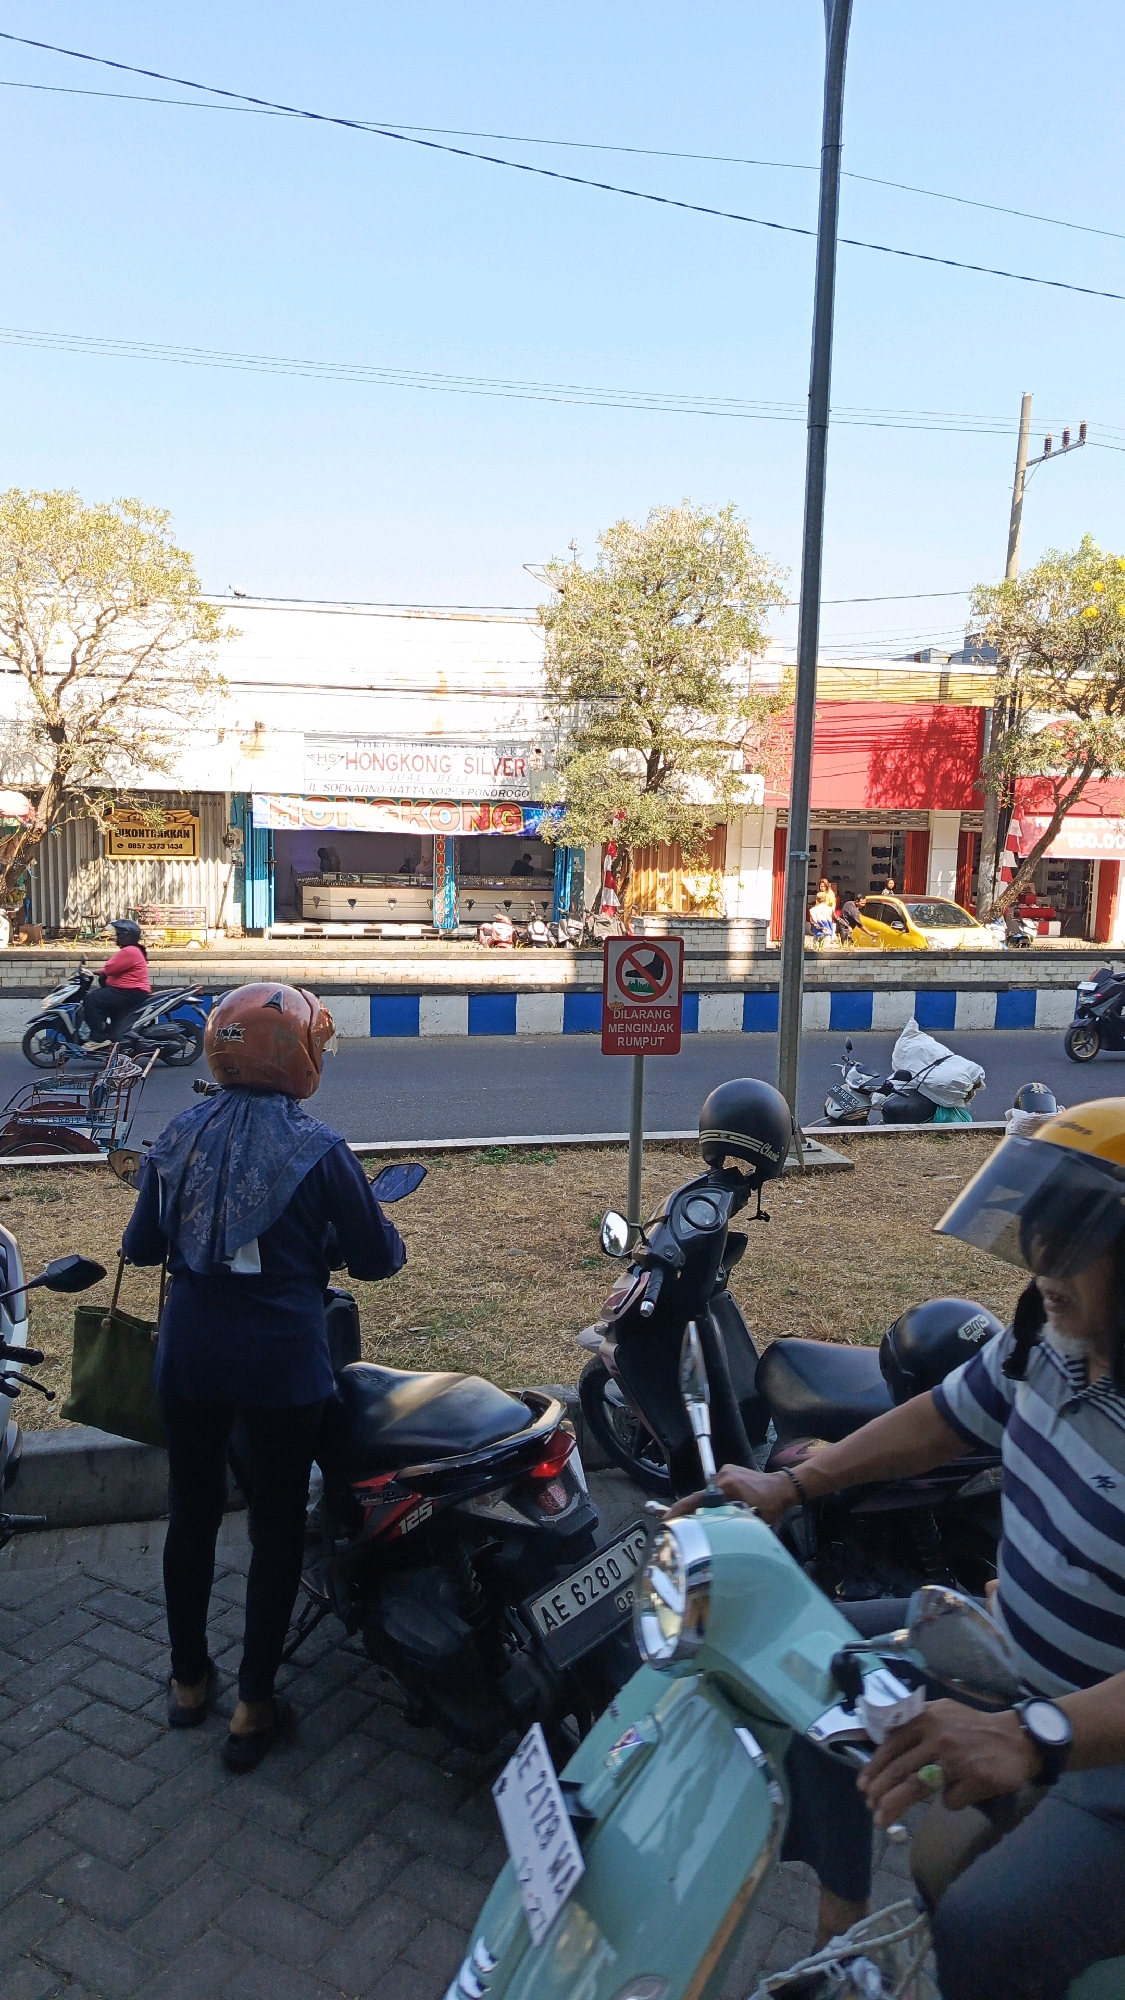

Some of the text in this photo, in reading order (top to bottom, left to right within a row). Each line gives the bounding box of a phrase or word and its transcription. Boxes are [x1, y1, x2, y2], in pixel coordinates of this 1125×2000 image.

[317, 753, 337, 763] HS
[345, 752, 526, 777] HONGKONG SILVER
[391, 773, 469, 782] JUAL BELI
[467, 788, 530, 798] PONOROGO
[268, 794, 523, 833] HONGKONG
[613, 1009, 671, 1019] DILARANG
[608, 1023, 674, 1033] MENGINJAK
[617, 1036, 665, 1046] RUMPUT
[398, 1501, 433, 1535] 125
[541, 1602, 571, 1631] AE
[570, 1557, 622, 1606] 6280
